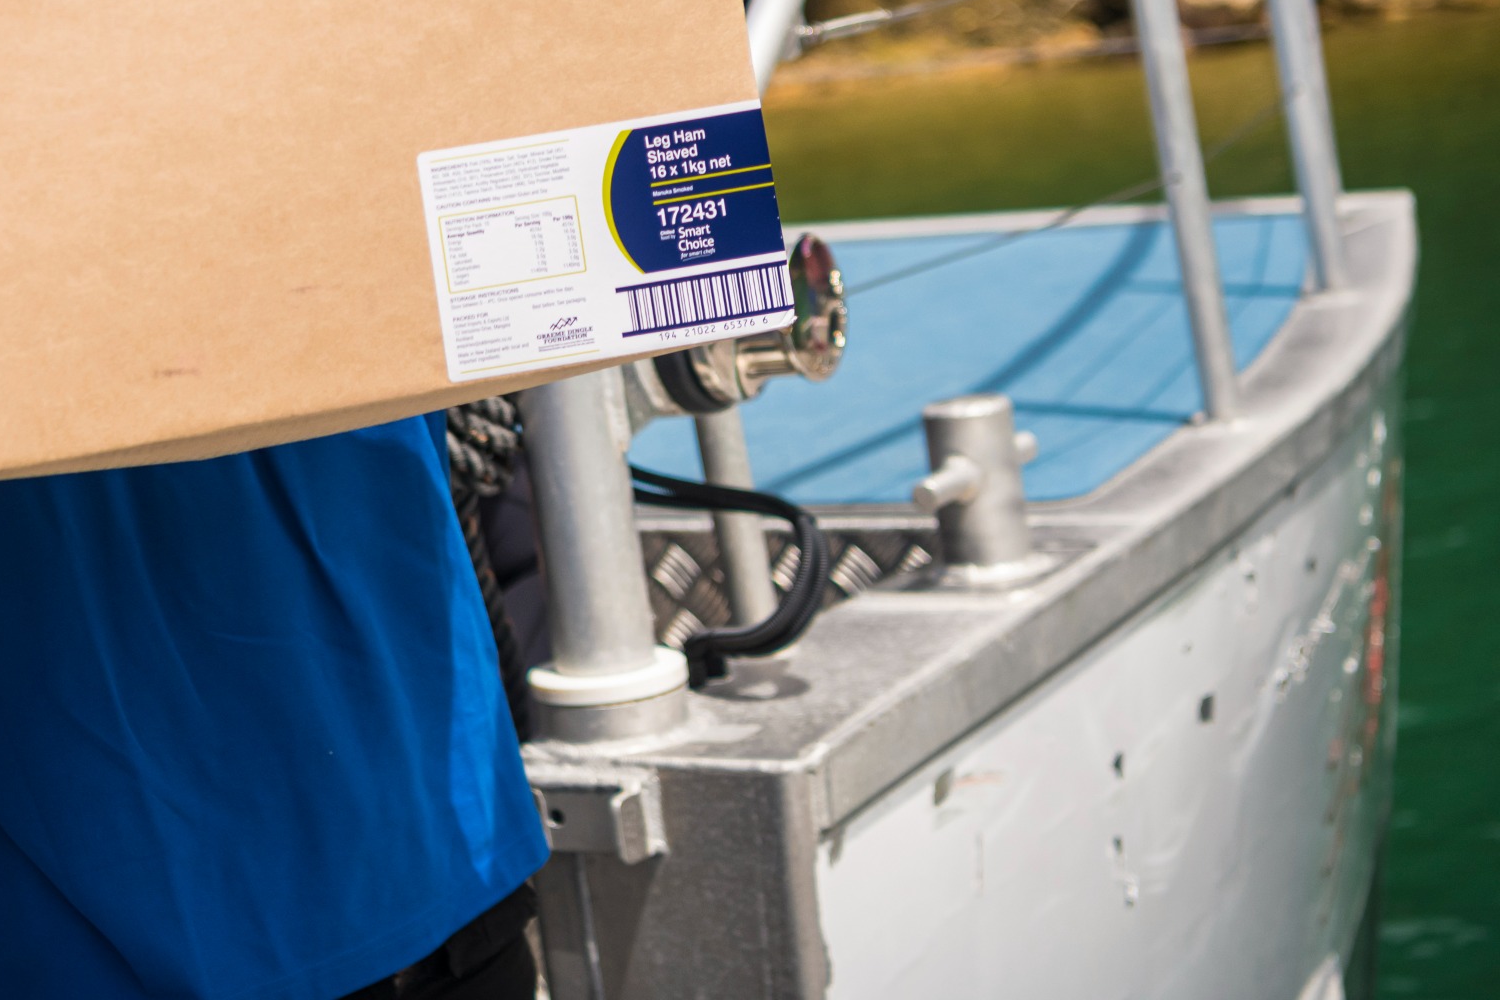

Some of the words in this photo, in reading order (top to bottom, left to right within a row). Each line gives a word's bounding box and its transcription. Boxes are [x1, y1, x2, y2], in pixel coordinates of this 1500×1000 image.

[645, 136, 670, 149] Leg
[674, 130, 705, 143] Ham
[648, 145, 698, 164] Shaved
[651, 166, 667, 179] 16
[670, 166, 678, 176] x
[682, 161, 706, 174] 1kg
[710, 155, 731, 169] net
[477, 211, 515, 220] INFORMATION
[658, 200, 726, 226] 172431
[679, 225, 711, 238] Smart
[679, 238, 714, 251] Choice
[478, 288, 519, 298] INSTRUCTIONS
[537, 331, 565, 340] GRAEME
[568, 327, 593, 335] DINGLE
[660, 332, 677, 341] 194
[685, 325, 716, 337] 21022
[724, 319, 755, 330] 65376
[763, 316, 768, 324] 6
[544, 333, 587, 344] FOUNDATION
